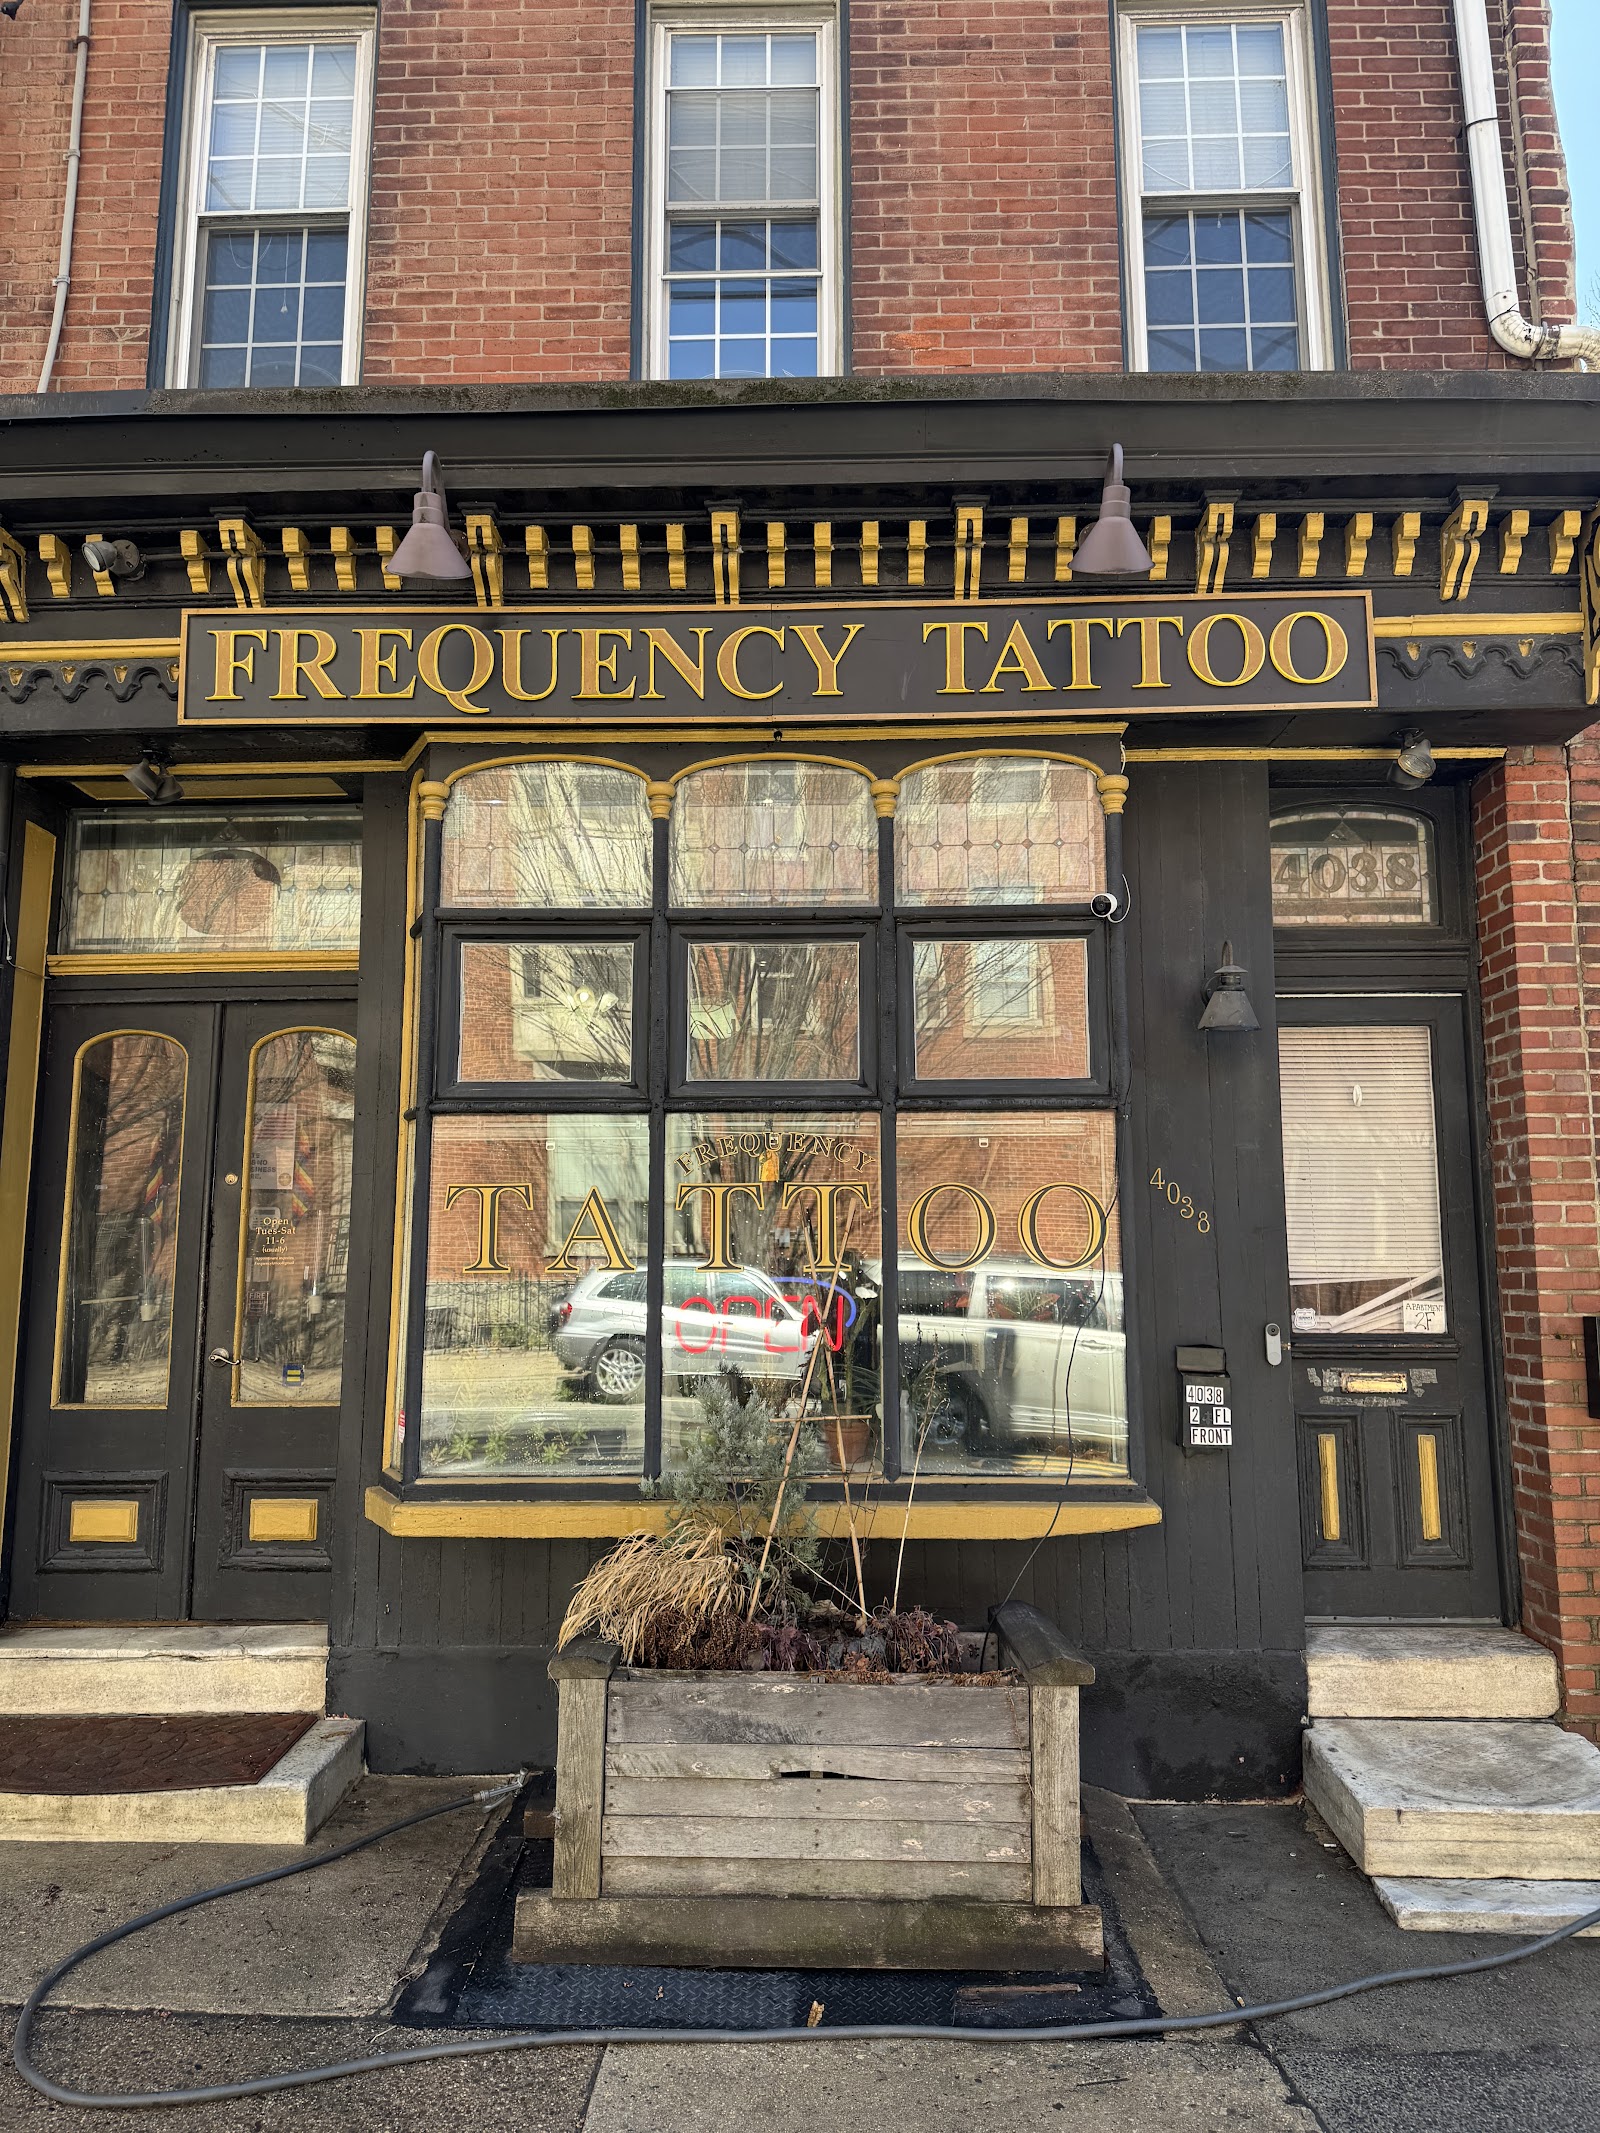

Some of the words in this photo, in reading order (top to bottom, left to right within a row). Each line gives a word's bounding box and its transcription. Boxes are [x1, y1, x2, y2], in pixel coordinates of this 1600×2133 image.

[205, 623, 865, 713] FREQUENCY
[921, 611, 1349, 694] TATTOO
[1273, 852, 1418, 893] 4038
[674, 1131, 876, 1177] FREQUENCY
[1149, 1167, 1211, 1233] 4038
[255, 1227, 296, 1235] Tues-Sat
[263, 1217, 289, 1227] Open
[444, 1182, 1110, 1274] TATTOO
[266, 1236, 285, 1244] 11-6
[675, 1294, 844, 1354] OPEN
[1414, 1311, 1435, 1331] 2F
[1188, 1386, 1222, 1403] 4038
[1191, 1408, 1199, 1423] 2
[1215, 1408, 1230, 1423] FL
[1192, 1428, 1230, 1444] FRONT
